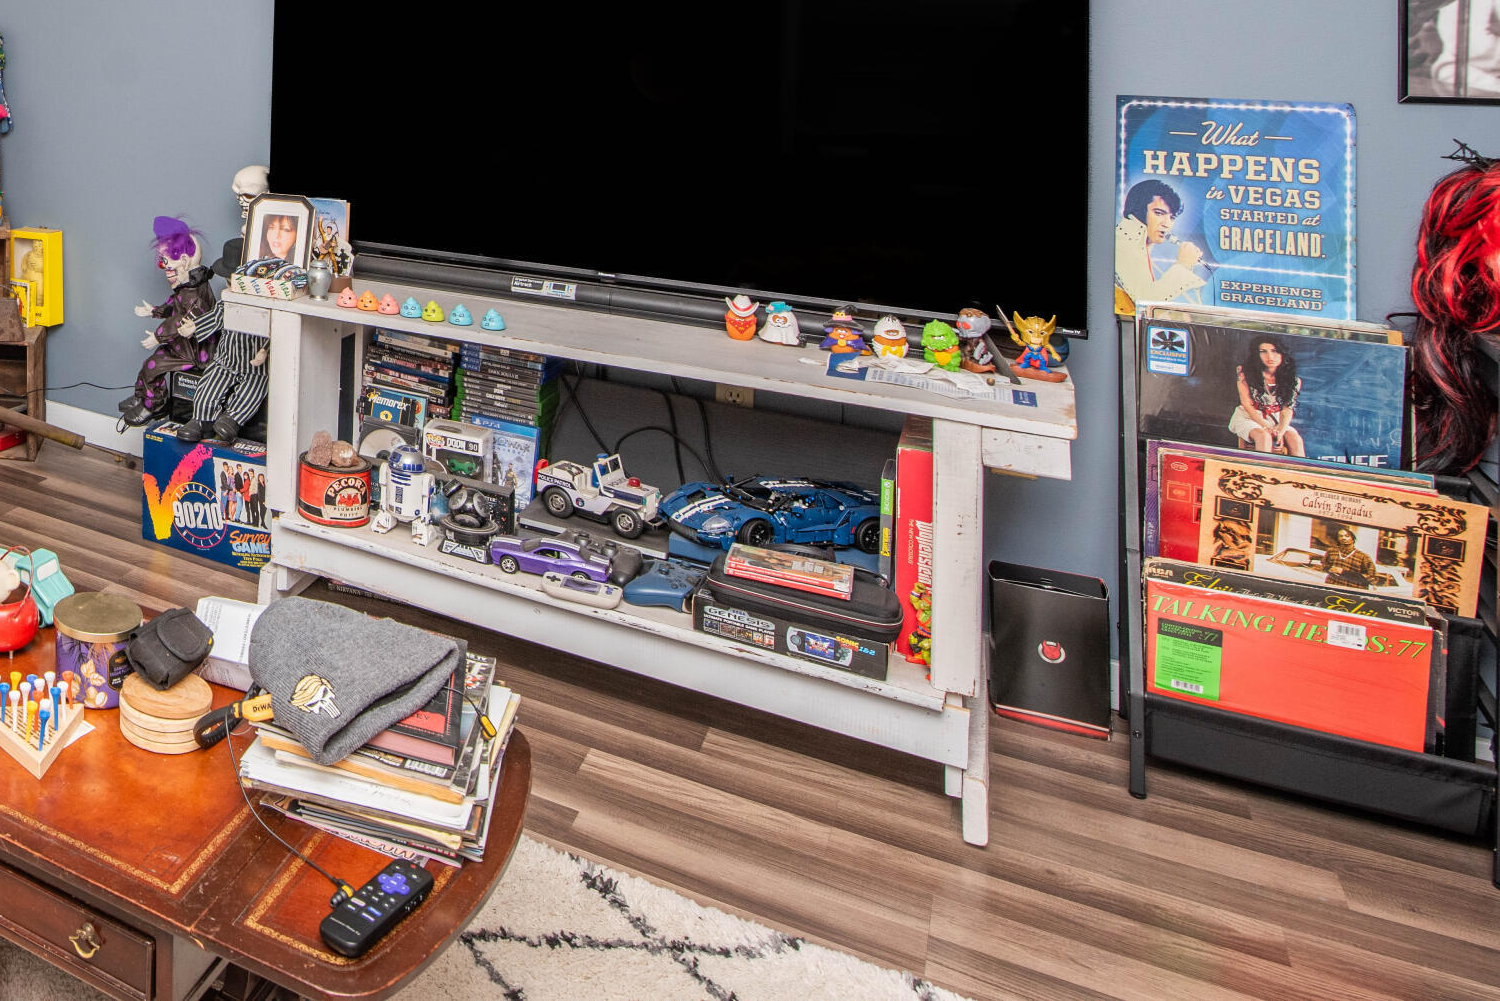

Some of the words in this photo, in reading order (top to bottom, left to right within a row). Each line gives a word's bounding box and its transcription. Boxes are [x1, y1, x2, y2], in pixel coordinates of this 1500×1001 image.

[1201, 120, 1260, 147] What
[1142, 150, 1321, 184] HAPPENS
[1205, 186, 1226, 200] in
[1228, 185, 1321, 209] VEGAS
[1220, 209, 1299, 226] STARTED
[1302, 215, 1321, 226] at
[1220, 280, 1323, 299] EXPERIENCE
[1220, 292, 1324, 311] GRACELAND
[368, 394, 409, 411] Memorex
[468, 442, 479, 452] 90
[172, 501, 224, 530] 90210
[1302, 496, 1332, 512] Calvin
[1334, 503, 1373, 519] Broadus
[230, 530, 272, 544] Survey
[232, 542, 271, 555] GAME
[336, 584, 361, 596] NIRVANA
[707, 607, 772, 629] GENESIS
[1386, 605, 1420, 617] VICTOR
[1151, 594, 1276, 633] TALKING
[1282, 619, 1394, 655] HES:
[1396, 638, 1428, 659] 77
[835, 636, 860, 649] SONIC
